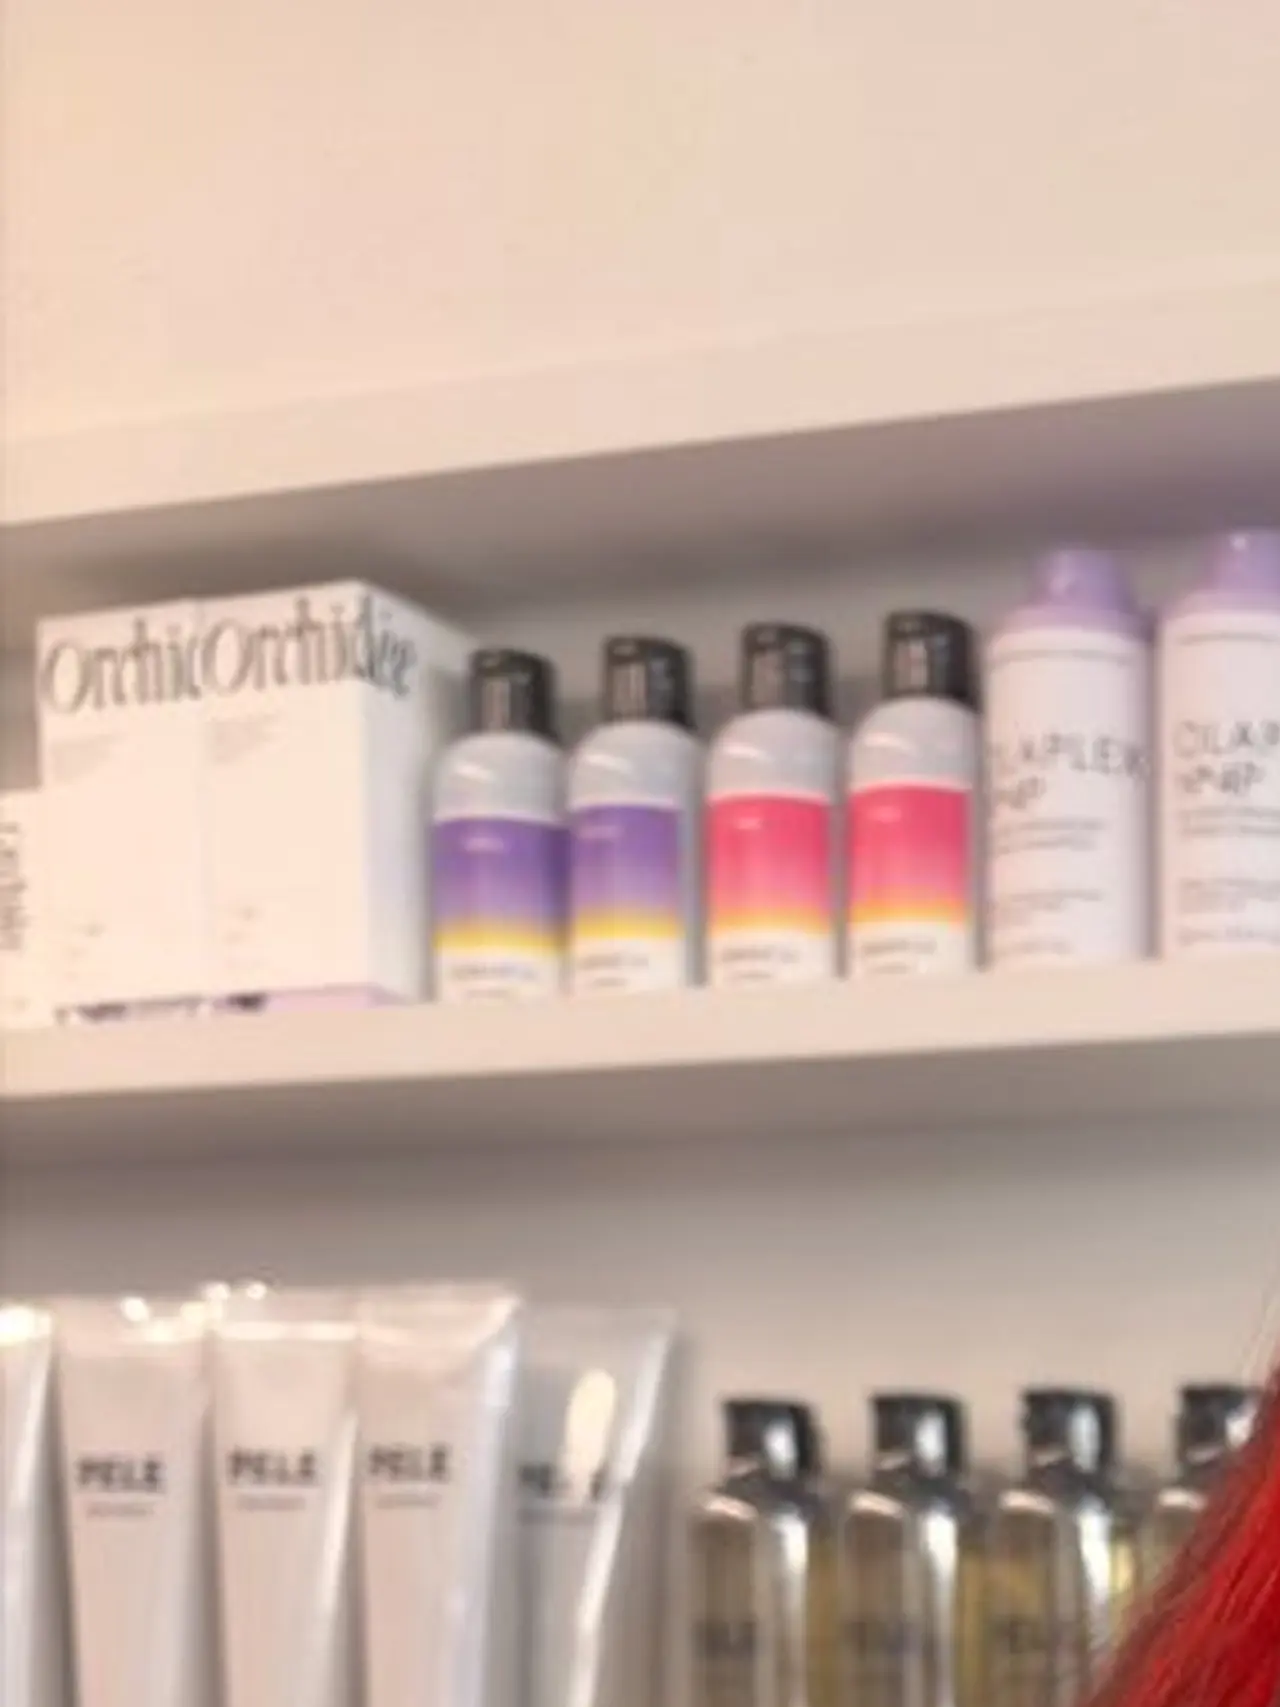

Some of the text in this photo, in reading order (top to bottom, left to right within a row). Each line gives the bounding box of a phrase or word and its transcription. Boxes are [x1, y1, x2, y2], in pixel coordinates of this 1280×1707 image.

[74, 1456, 167, 1494] PELE
[227, 1448, 320, 1488] PELE
[368, 1443, 450, 1484] PELE
